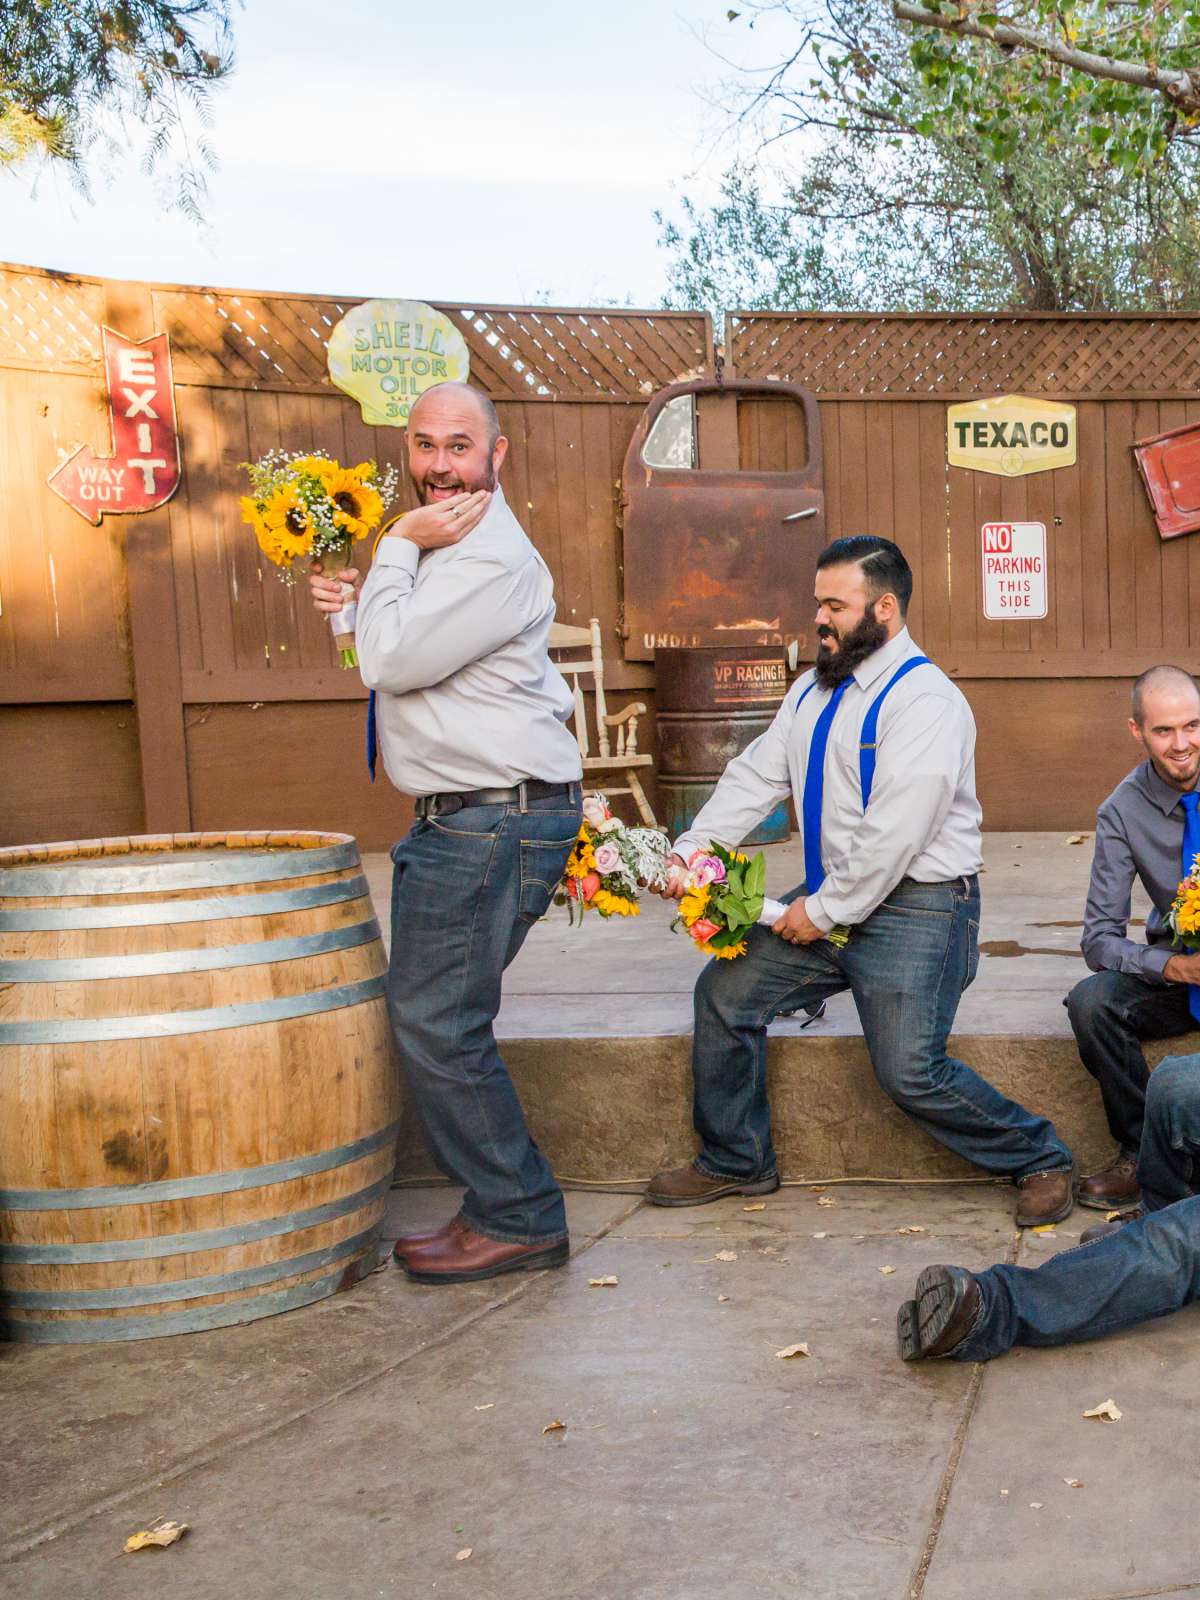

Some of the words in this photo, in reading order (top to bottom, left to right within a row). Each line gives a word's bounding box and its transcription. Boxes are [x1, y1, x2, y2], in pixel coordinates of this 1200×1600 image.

[354, 321, 445, 356] SHELL
[351, 353, 447, 377] MOTOR
[380, 375, 420, 395] OIL
[119, 349, 166, 494] EXIT
[954, 421, 1069, 448] TEXACO
[78, 466, 124, 485] WAY
[80, 484, 125, 501] OUT
[985, 527, 1010, 551] NO
[987, 556, 1041, 574] PARKING
[998, 580, 1031, 592] THIS
[1000, 595, 1030, 607] SIDE
[715, 666, 732, 682] VP
[736, 665, 776, 682] RACING
